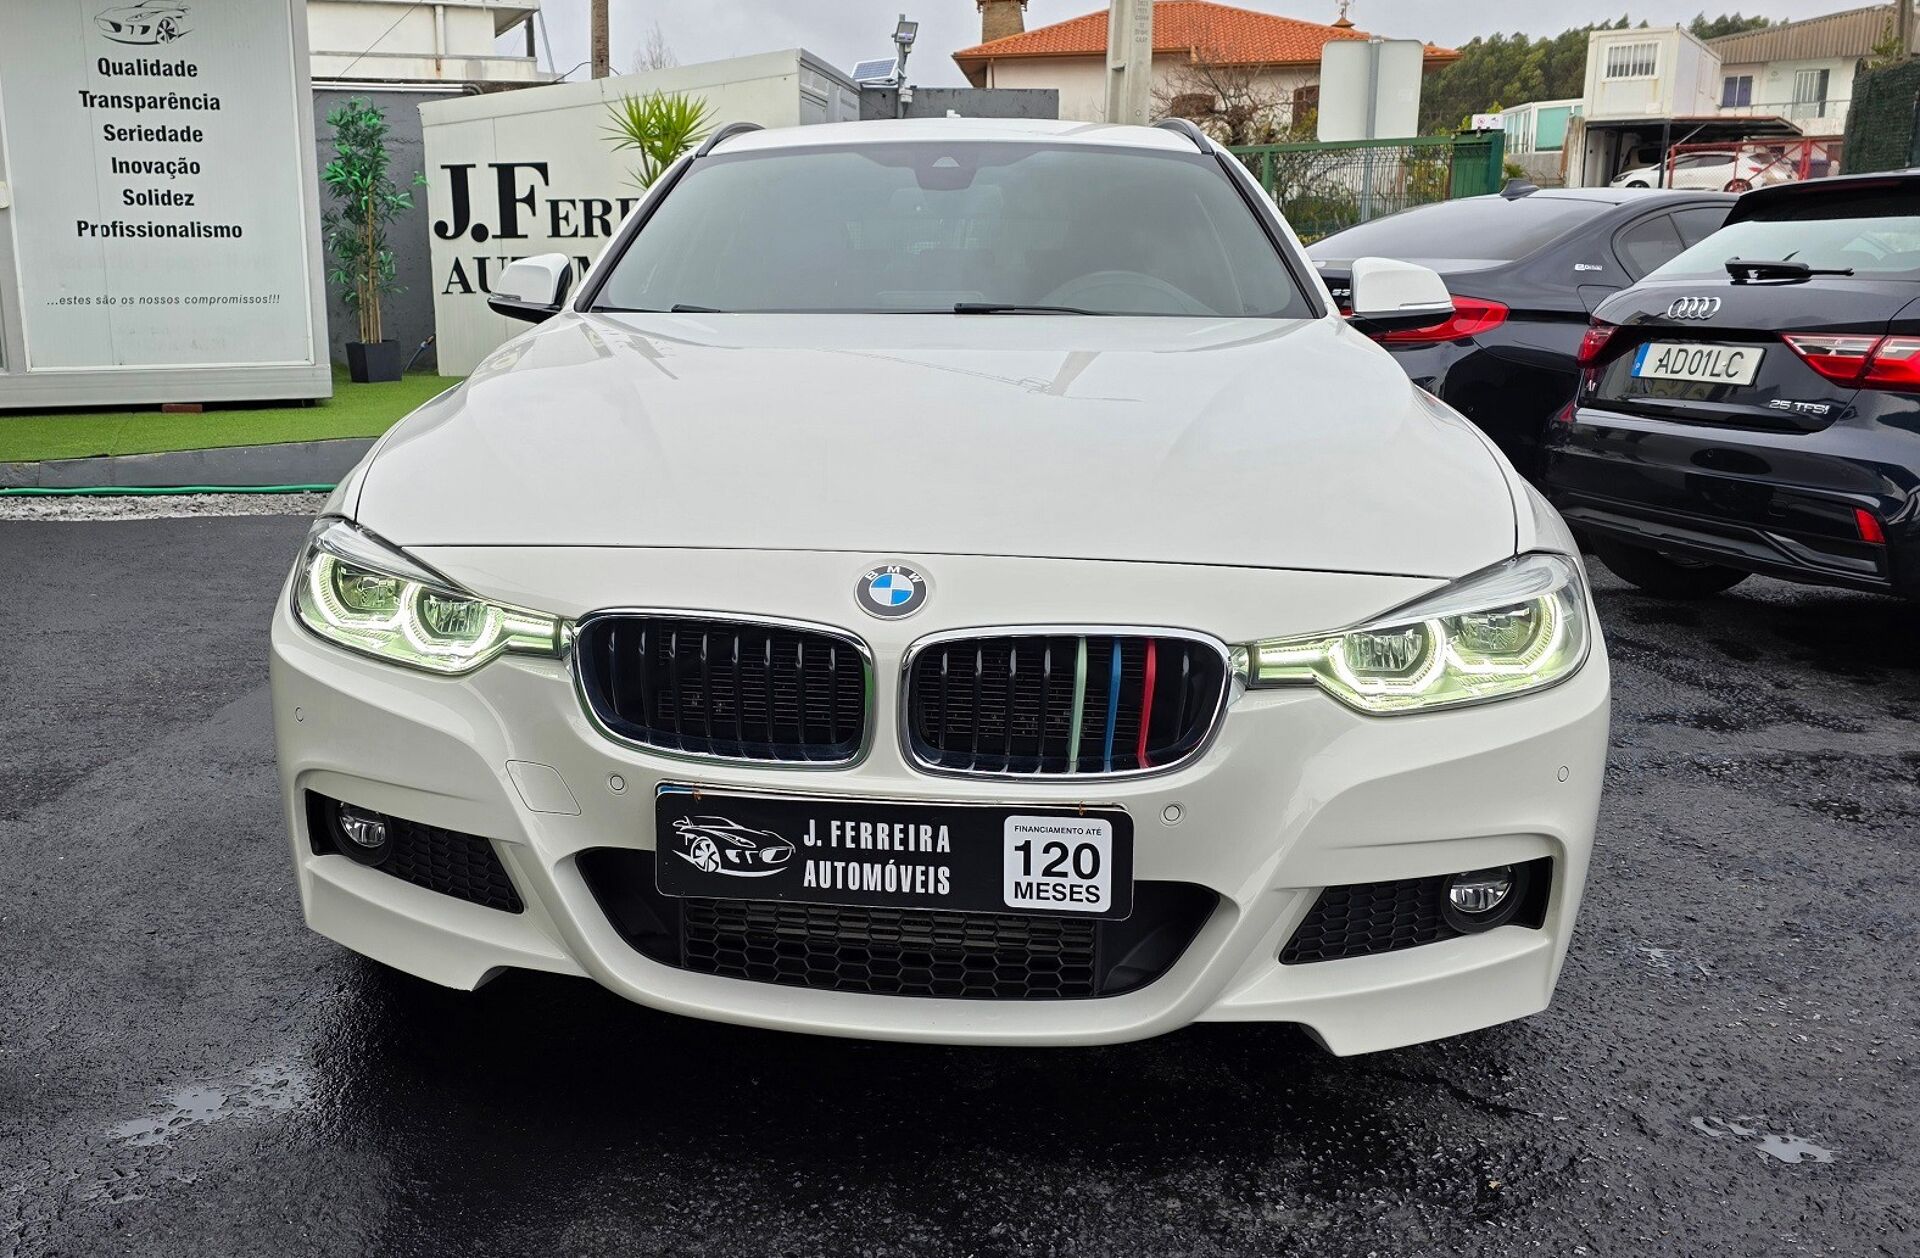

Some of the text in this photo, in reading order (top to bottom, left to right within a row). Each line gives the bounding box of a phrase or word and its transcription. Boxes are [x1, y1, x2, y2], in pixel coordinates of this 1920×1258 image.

[97, 57, 198, 77] Qualidade
[78, 90, 221, 113] Transparência
[103, 123, 203, 143] Seriedade
[111, 156, 201, 180] Inovação
[122, 188, 195, 206] Solidez
[76, 220, 243, 238] Profissionalismo
[96, 294, 117, 305] são
[121, 296, 135, 305] os
[138, 296, 180, 305] nossos
[184, 294, 281, 306] compromissos!!!
[1654, 347, 1744, 378] AD01LC
[1769, 399, 1830, 415] 25 TFSI
[864, 565, 923, 583] BMW
[803, 818, 951, 853] J. FERREIRA
[1014, 825, 1102, 836] FINANCIAMENTO ATÉ
[1014, 839, 1101, 880] 120
[803, 859, 950, 895] AUTOMÓVEIS
[1014, 881, 1101, 904] MESES
